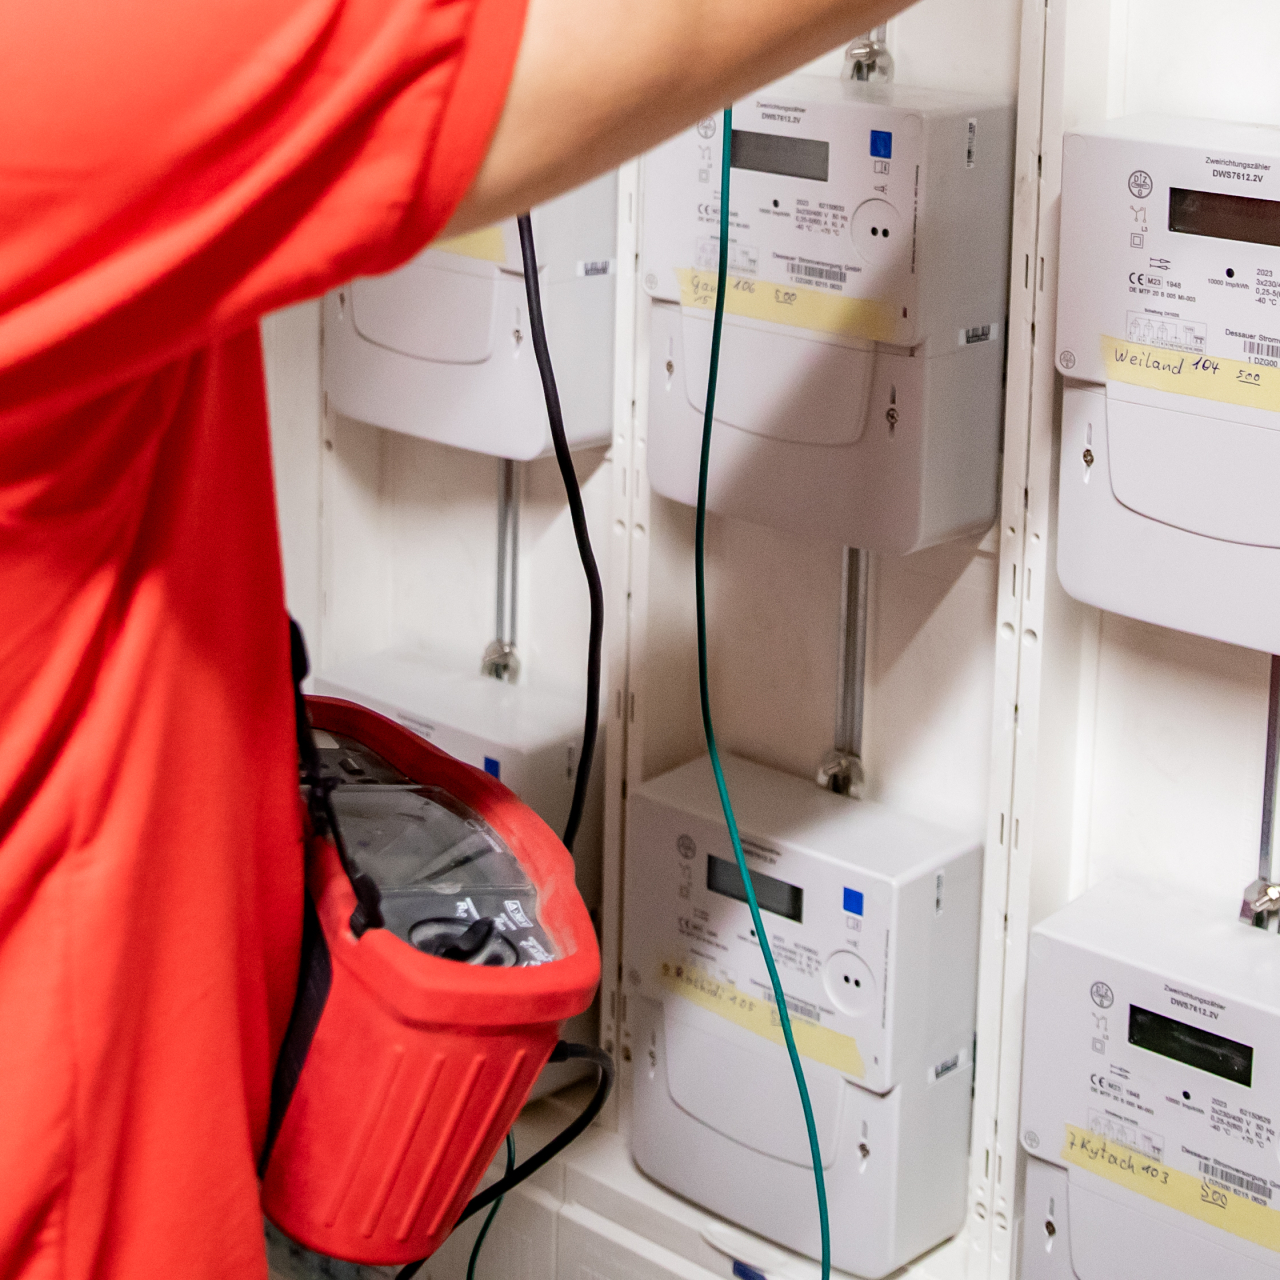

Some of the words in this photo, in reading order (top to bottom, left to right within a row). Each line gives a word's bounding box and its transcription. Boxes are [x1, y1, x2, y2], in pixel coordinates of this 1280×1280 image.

[1205, 156, 1271, 171] Zweirichtungszähler
[1212, 169, 1264, 183] DWS7612.2V
[1256, 268, 1273, 277] 2023
[1147, 277, 1161, 286] M23
[1166, 280, 1182, 289] 1948
[1225, 328, 1257, 340] Dessauer
[1115, 348, 1184, 375] Weiland
[1235, 369, 1261, 381] 500
